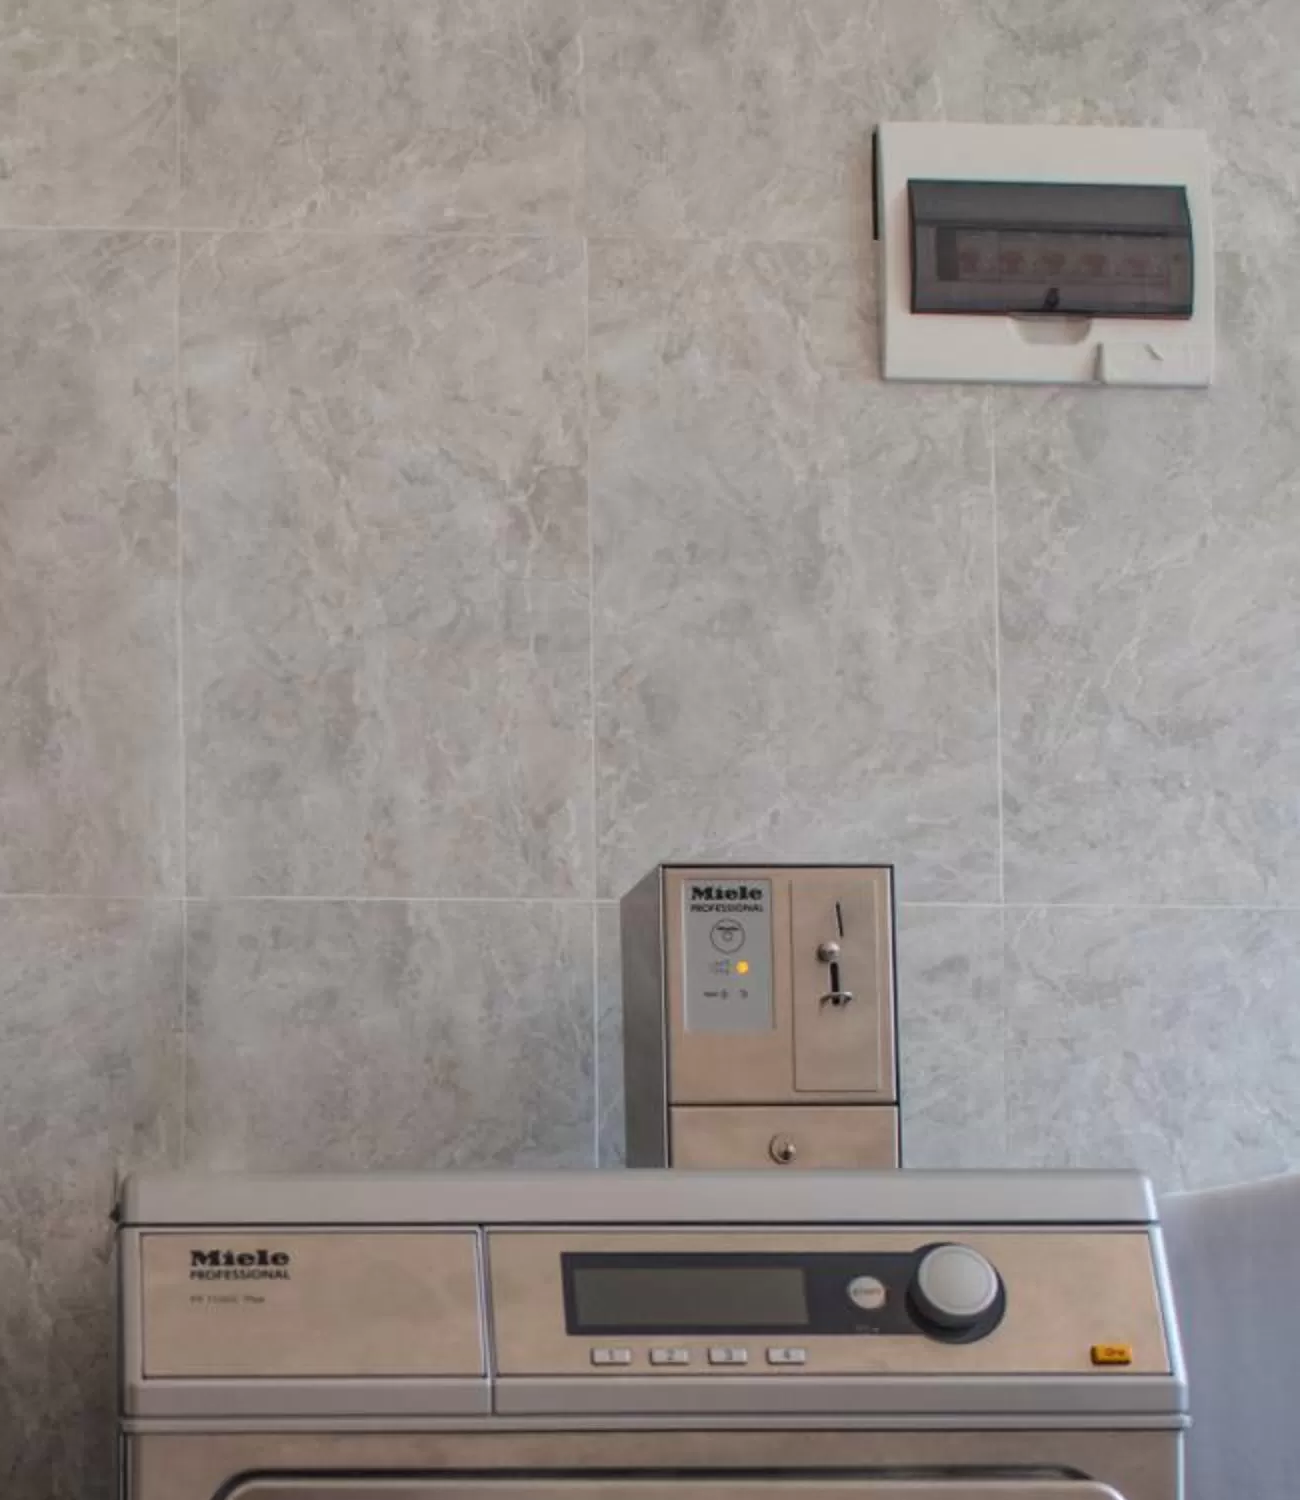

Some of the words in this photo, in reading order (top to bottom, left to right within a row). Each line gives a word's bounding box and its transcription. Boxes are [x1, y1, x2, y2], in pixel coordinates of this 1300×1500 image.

[691, 886, 763, 901] Miele
[690, 903, 764, 913] PROFESSIONAL
[189, 1249, 290, 1266] Miele
[189, 1269, 292, 1280] PROFESSIONAL
